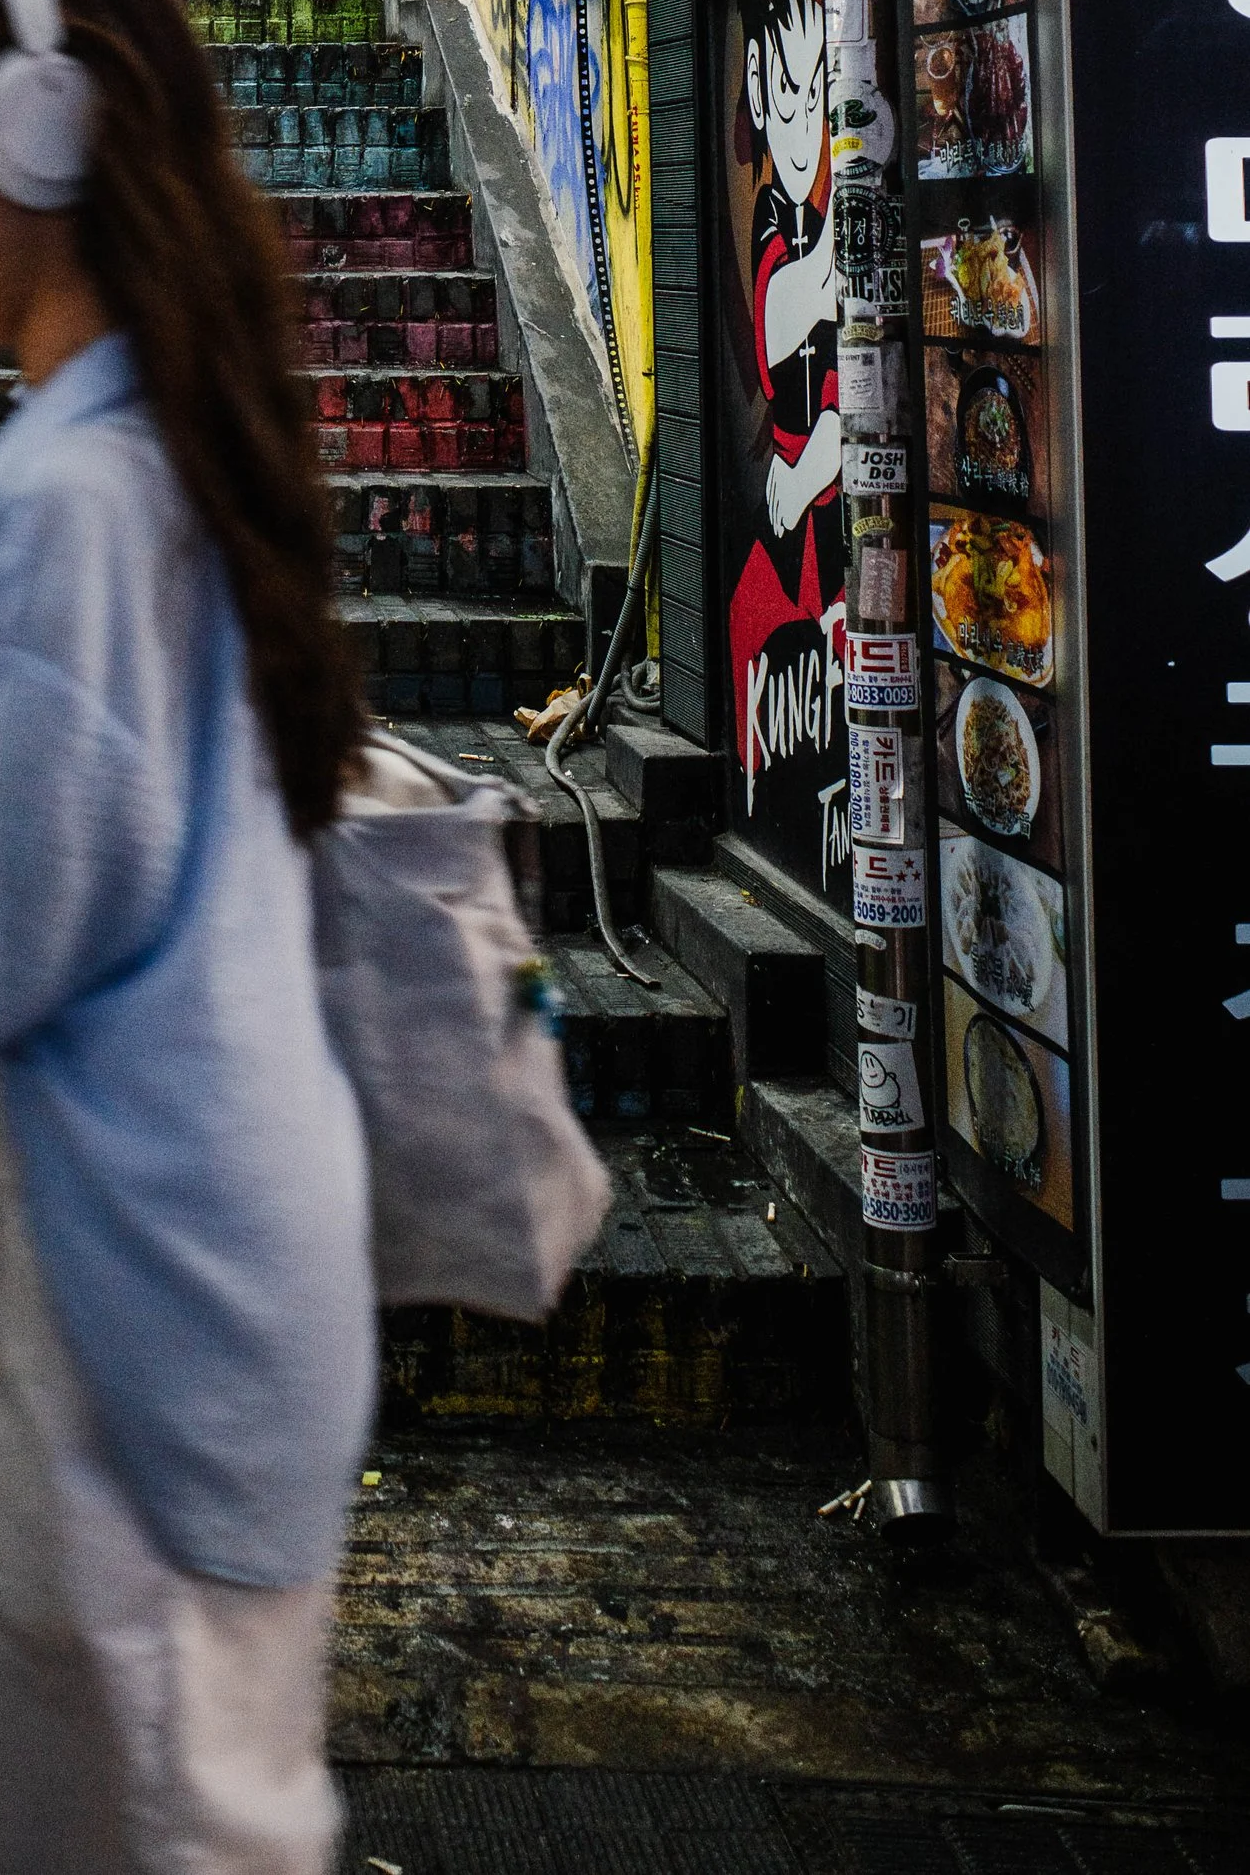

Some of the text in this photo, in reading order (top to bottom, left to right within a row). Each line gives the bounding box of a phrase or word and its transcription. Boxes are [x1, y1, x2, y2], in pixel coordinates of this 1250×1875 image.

[861, 451, 904, 466] JOSH
[860, 481, 906, 490] WAS HERE
[873, 736, 895, 783] 카드
